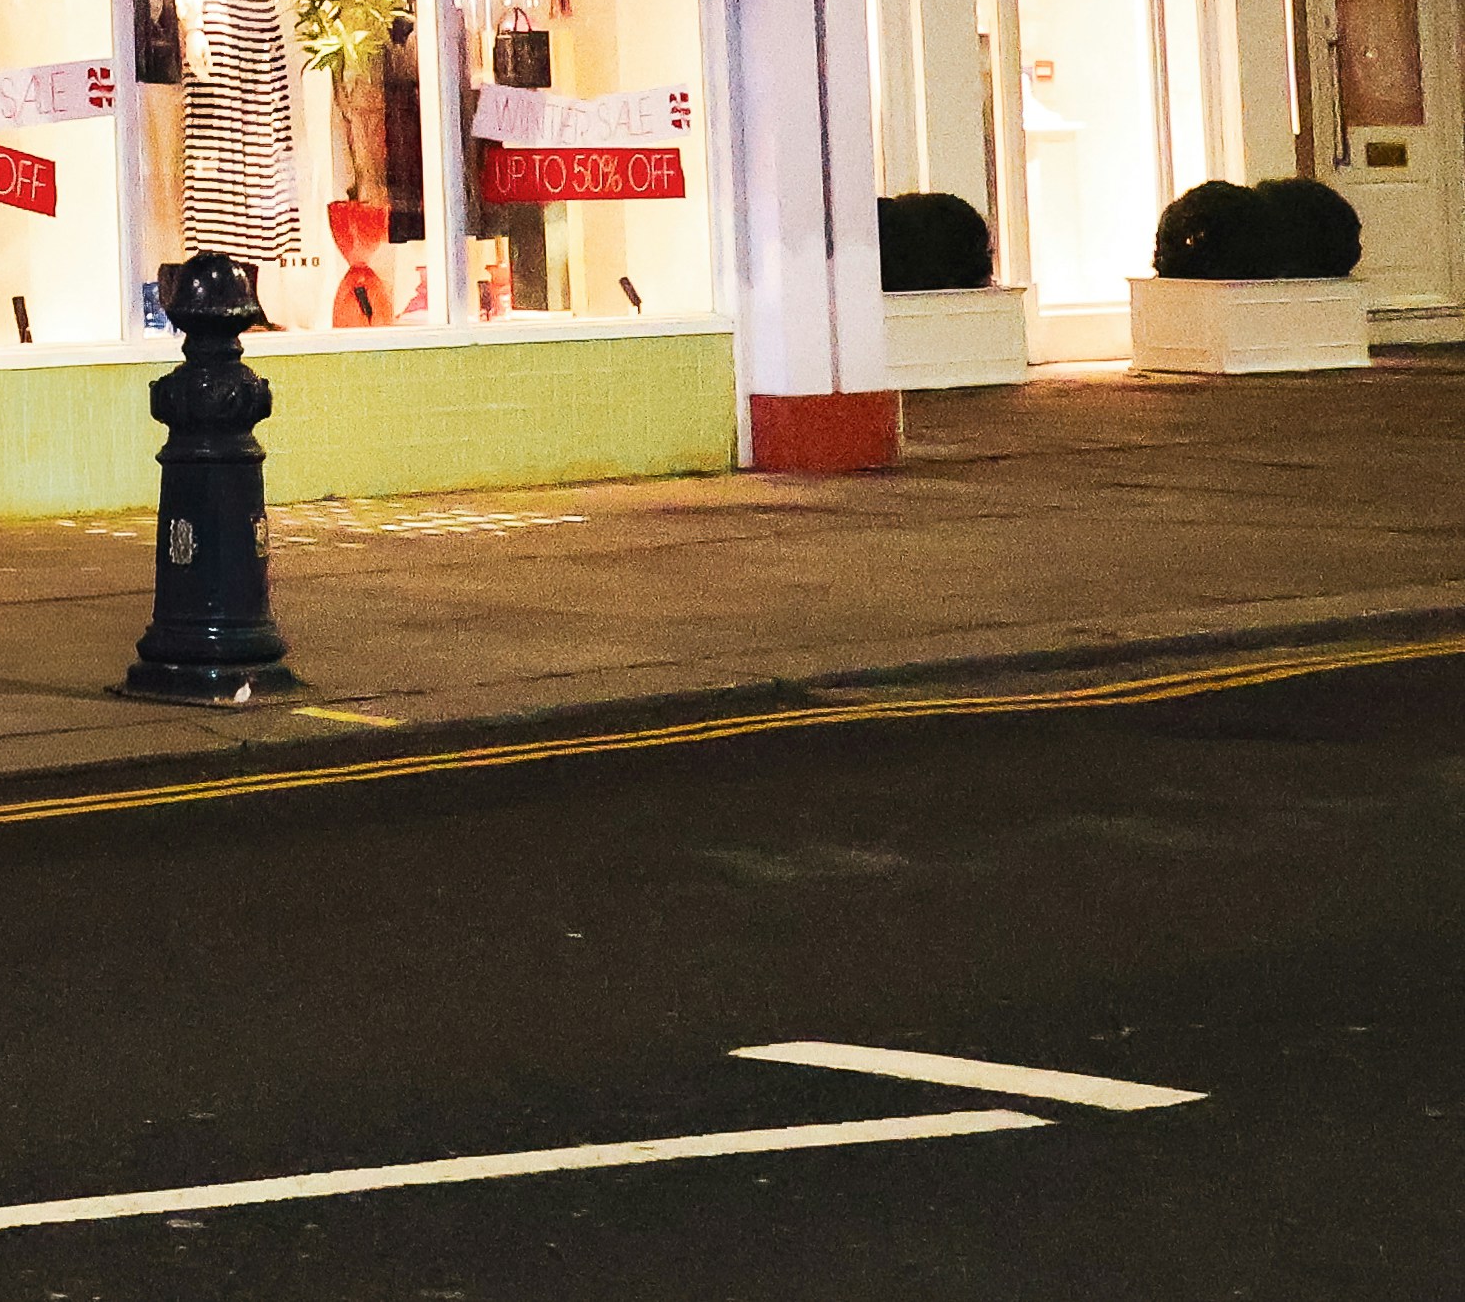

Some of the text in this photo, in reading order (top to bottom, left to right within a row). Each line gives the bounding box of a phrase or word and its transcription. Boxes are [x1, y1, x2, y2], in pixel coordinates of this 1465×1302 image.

[2, 70, 68, 120] SALE
[495, 153, 676, 193] UP TO 50% OFF
